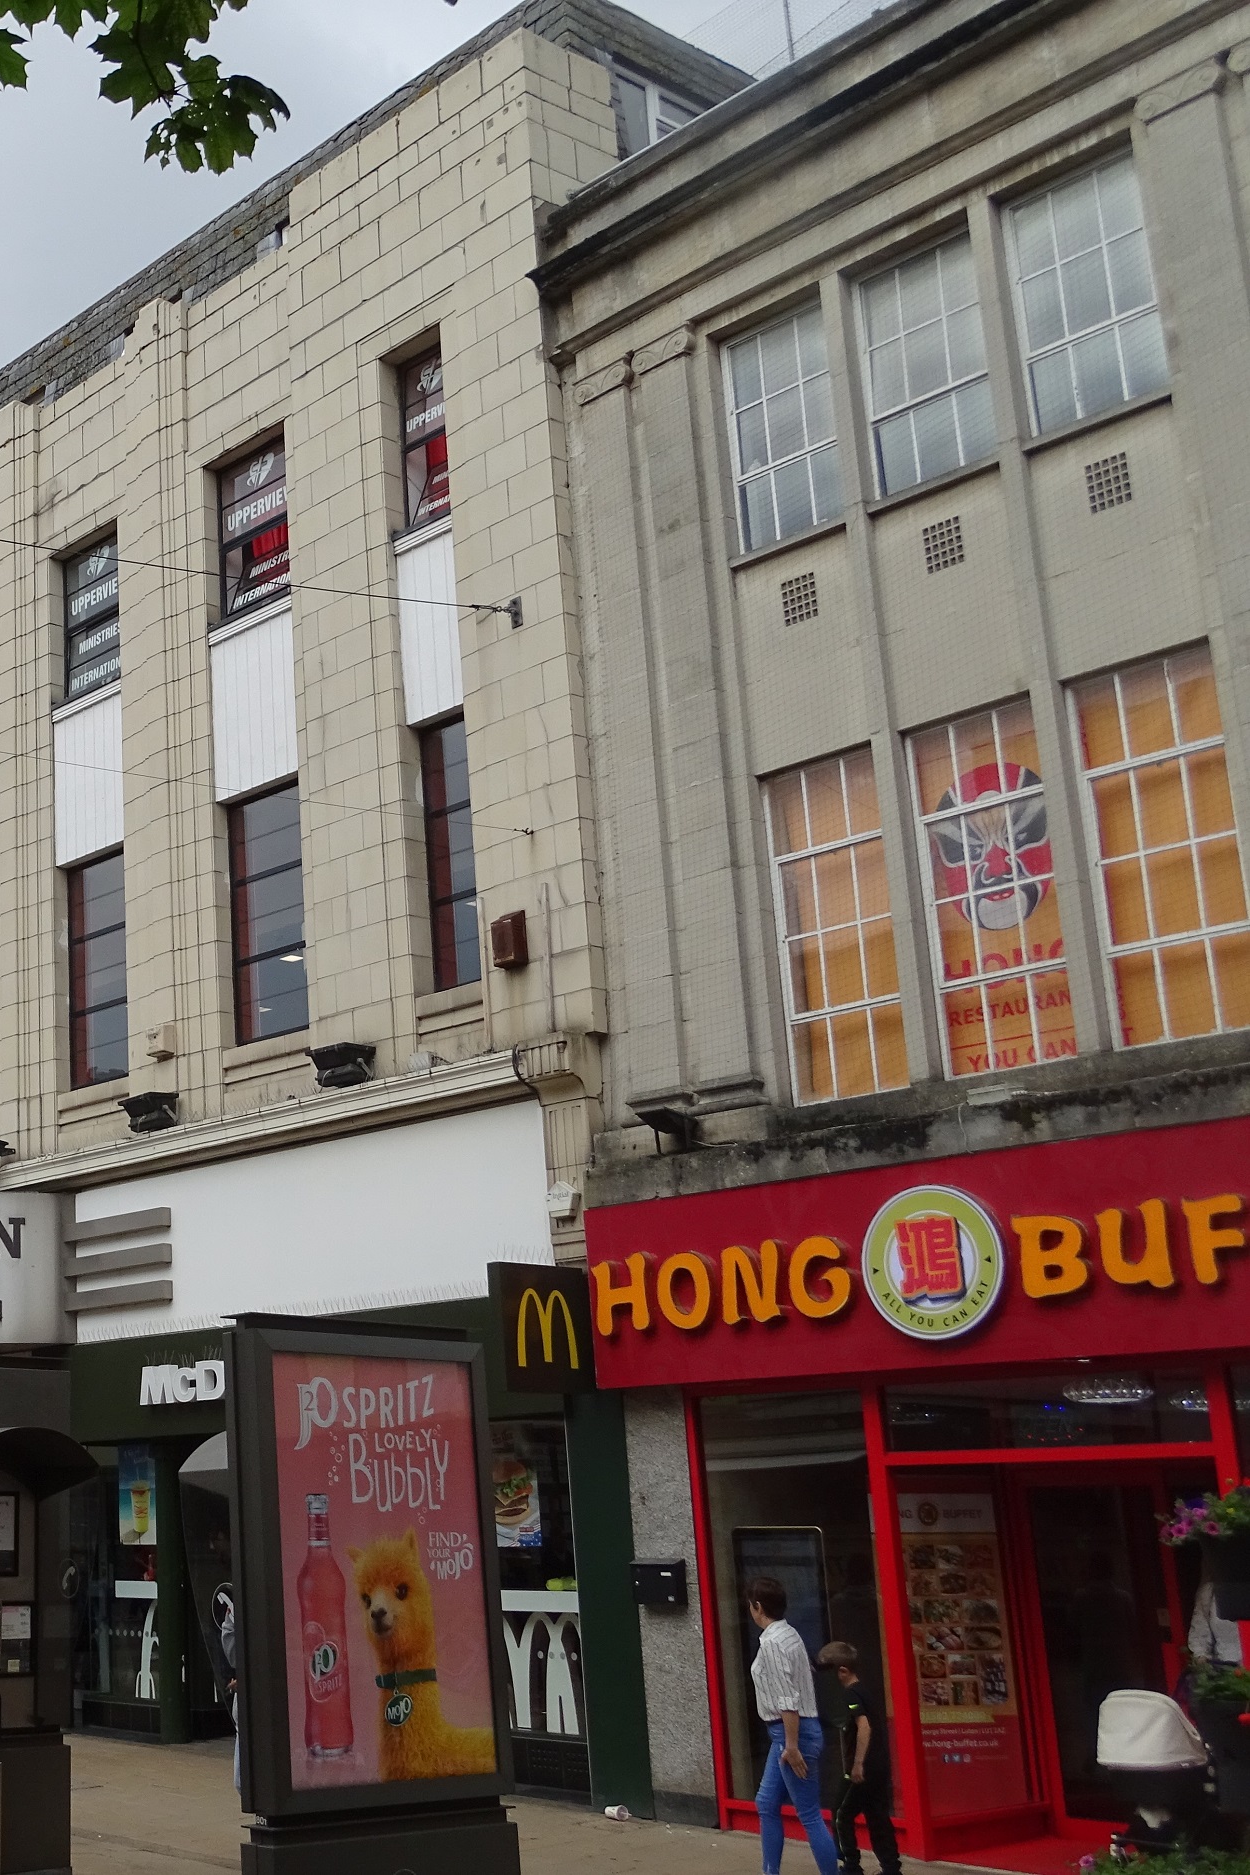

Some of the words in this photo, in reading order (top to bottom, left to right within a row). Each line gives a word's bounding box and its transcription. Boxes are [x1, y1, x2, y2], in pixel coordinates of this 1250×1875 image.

[249, 550, 290, 579] MINISTR
[591, 1236, 852, 1337] HONG
[882, 1292, 902, 1314] ALL
[909, 1313, 934, 1328] YOU
[943, 1309, 968, 1327] CAN
[970, 1280, 989, 1306] EAT
[342, 1373, 435, 1430] SPRITZ
[374, 1428, 432, 1453] LOVELY
[428, 1531, 462, 1547] FIND
[426, 1548, 451, 1558] YOUR
[387, 1697, 411, 1722] MOJO
